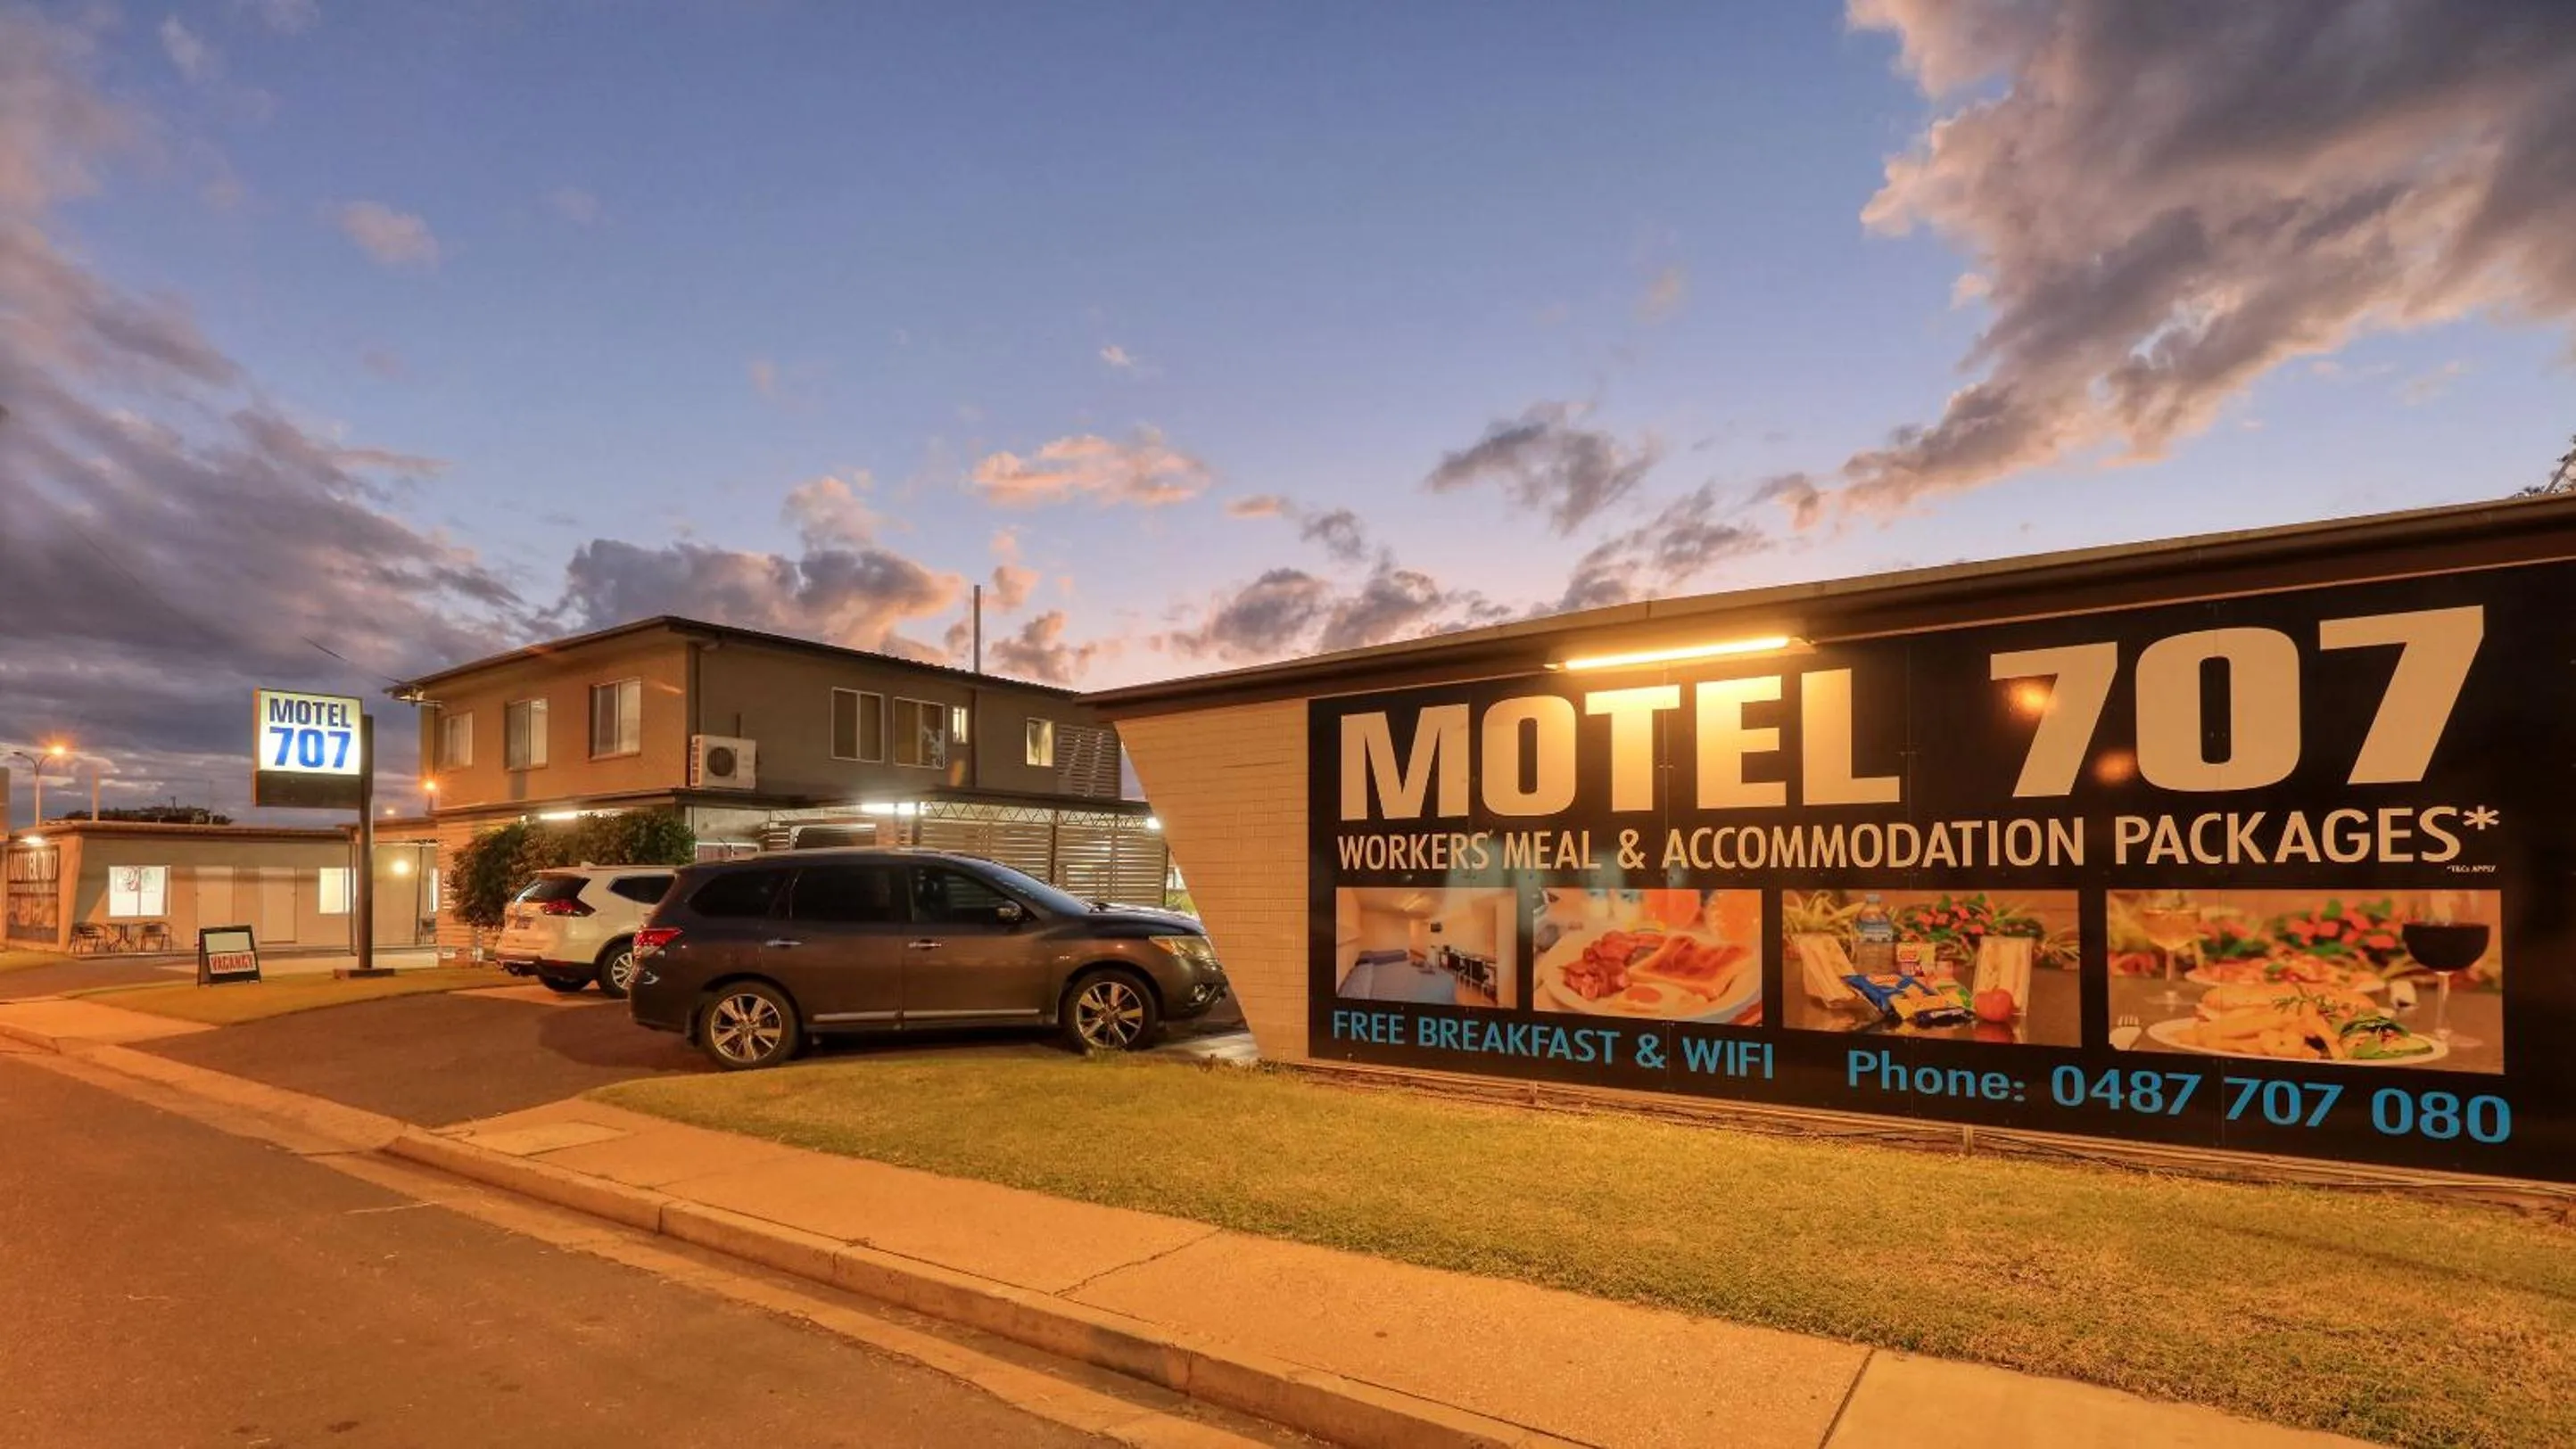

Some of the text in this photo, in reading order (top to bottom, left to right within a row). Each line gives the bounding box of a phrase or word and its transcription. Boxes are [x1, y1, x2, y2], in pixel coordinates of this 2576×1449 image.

[269, 697, 351, 729] MOTEL
[1340, 605, 2485, 821] MOTEL 707
[269, 726, 351, 769] 707
[1503, 829, 1601, 870] MEAL
[1616, 827, 1645, 869] &
[1663, 818, 2085, 869] ACCOMMODATION
[211, 954, 254, 971] VACANCY
[1333, 1010, 1773, 1079] FREE BREAKFAST & WIFI
[1848, 1050, 2512, 1144] Phone: 0487 707 080
